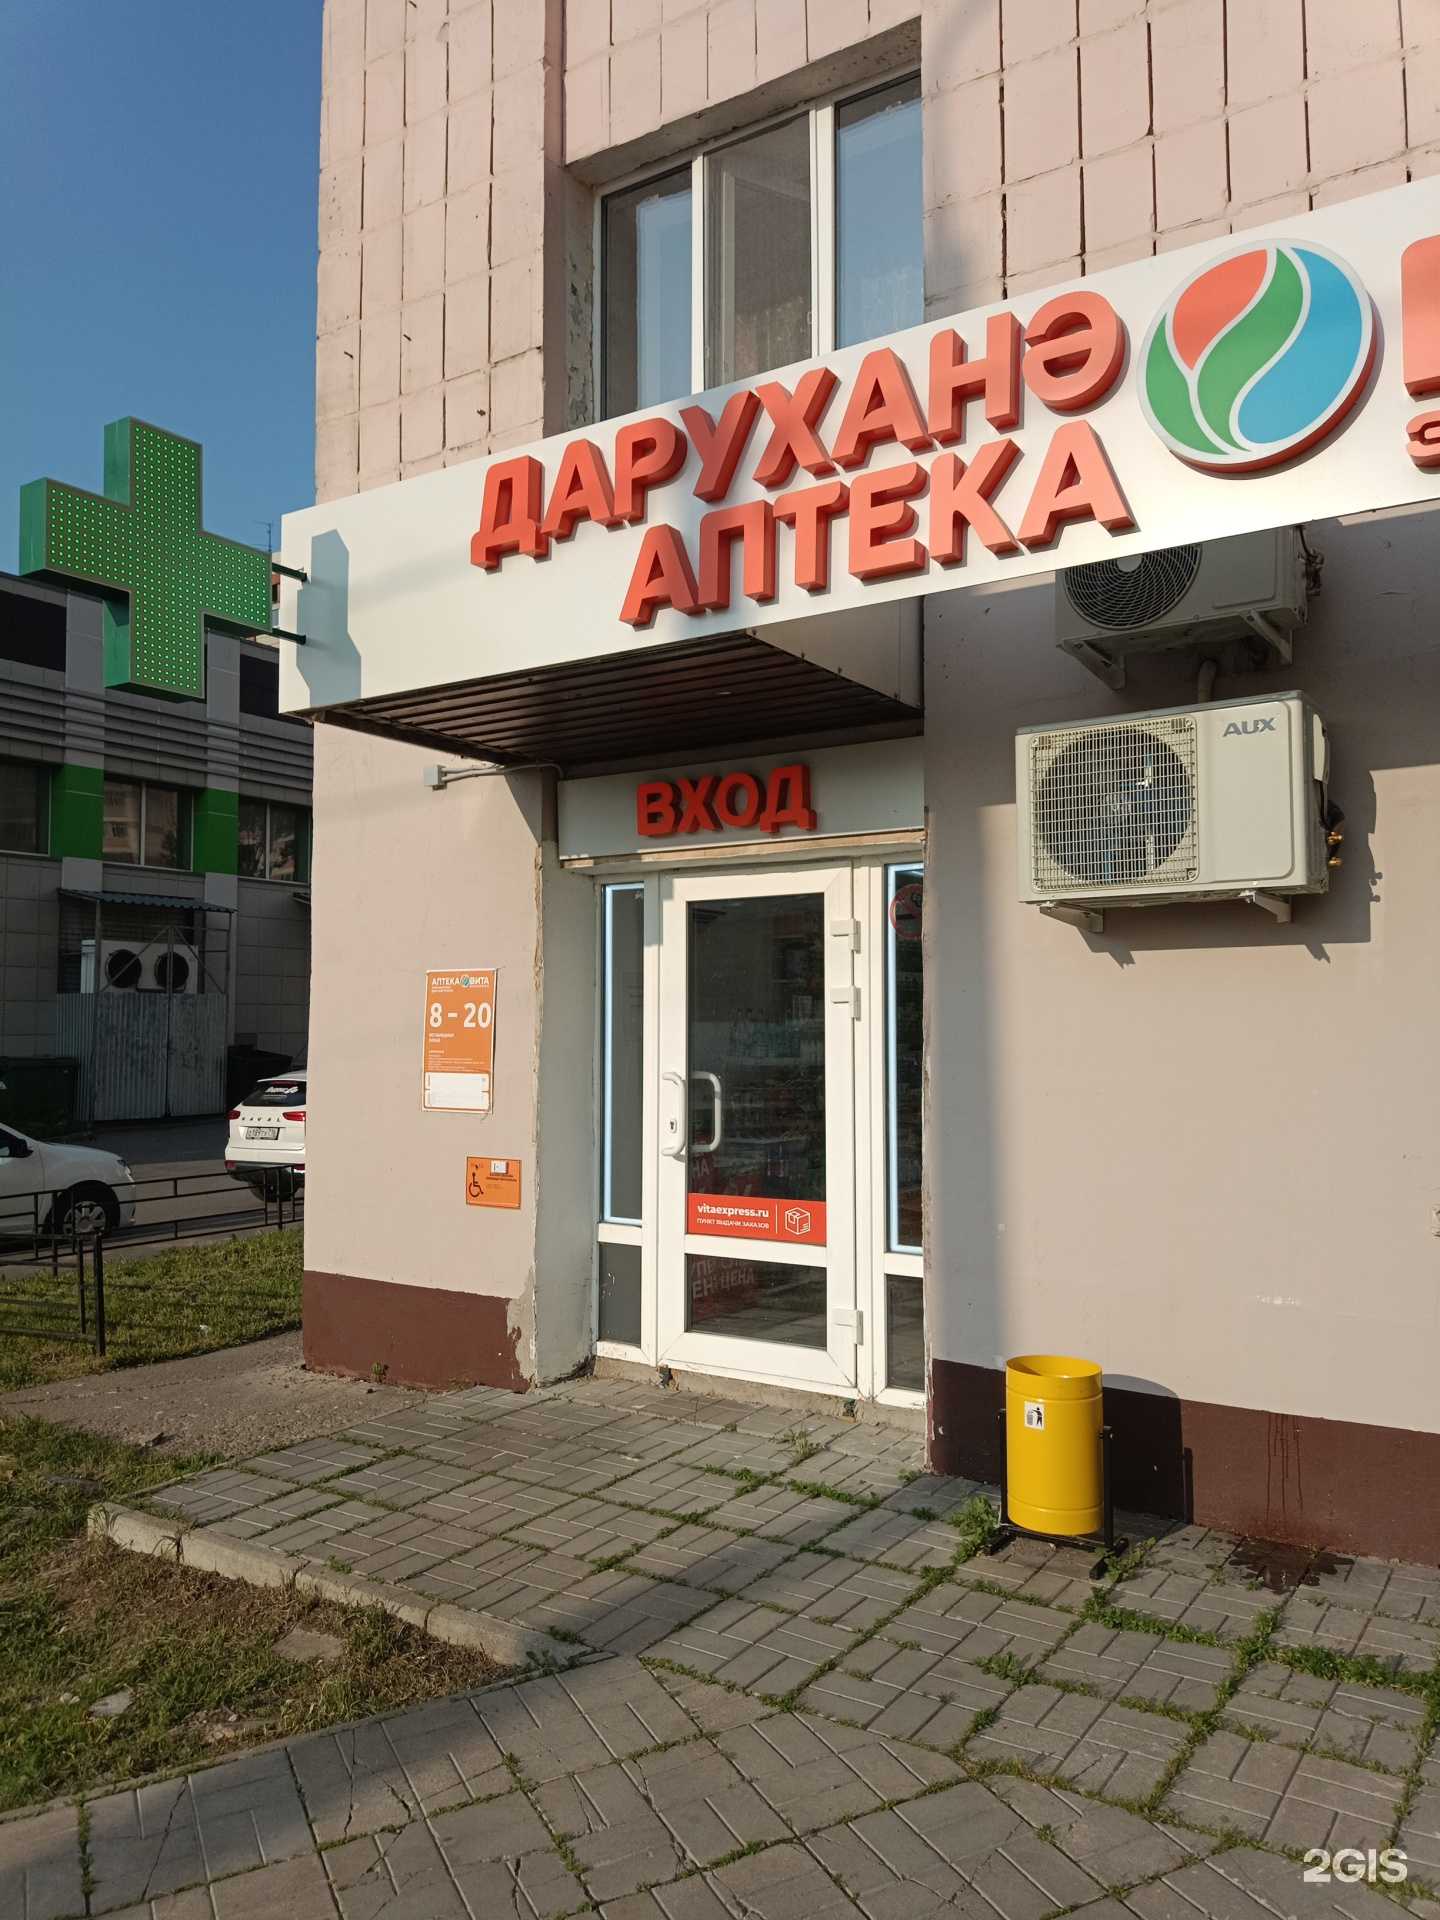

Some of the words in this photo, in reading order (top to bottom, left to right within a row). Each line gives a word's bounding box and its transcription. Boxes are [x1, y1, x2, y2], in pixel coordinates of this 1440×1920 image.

[470, 289, 1129, 571] ДАРУХАНӘ
[620, 420, 1136, 628] АПТЕКА
[1222, 717, 1276, 737] AUX
[636, 764, 817, 837] ВХОД
[431, 977, 460, 986] АПТЕКА
[469, 976, 489, 985] ВИТА
[430, 1002, 442, 1028] 8
[463, 1002, 492, 1028] 20
[697, 1203, 769, 1218] vitaexpress.ru
